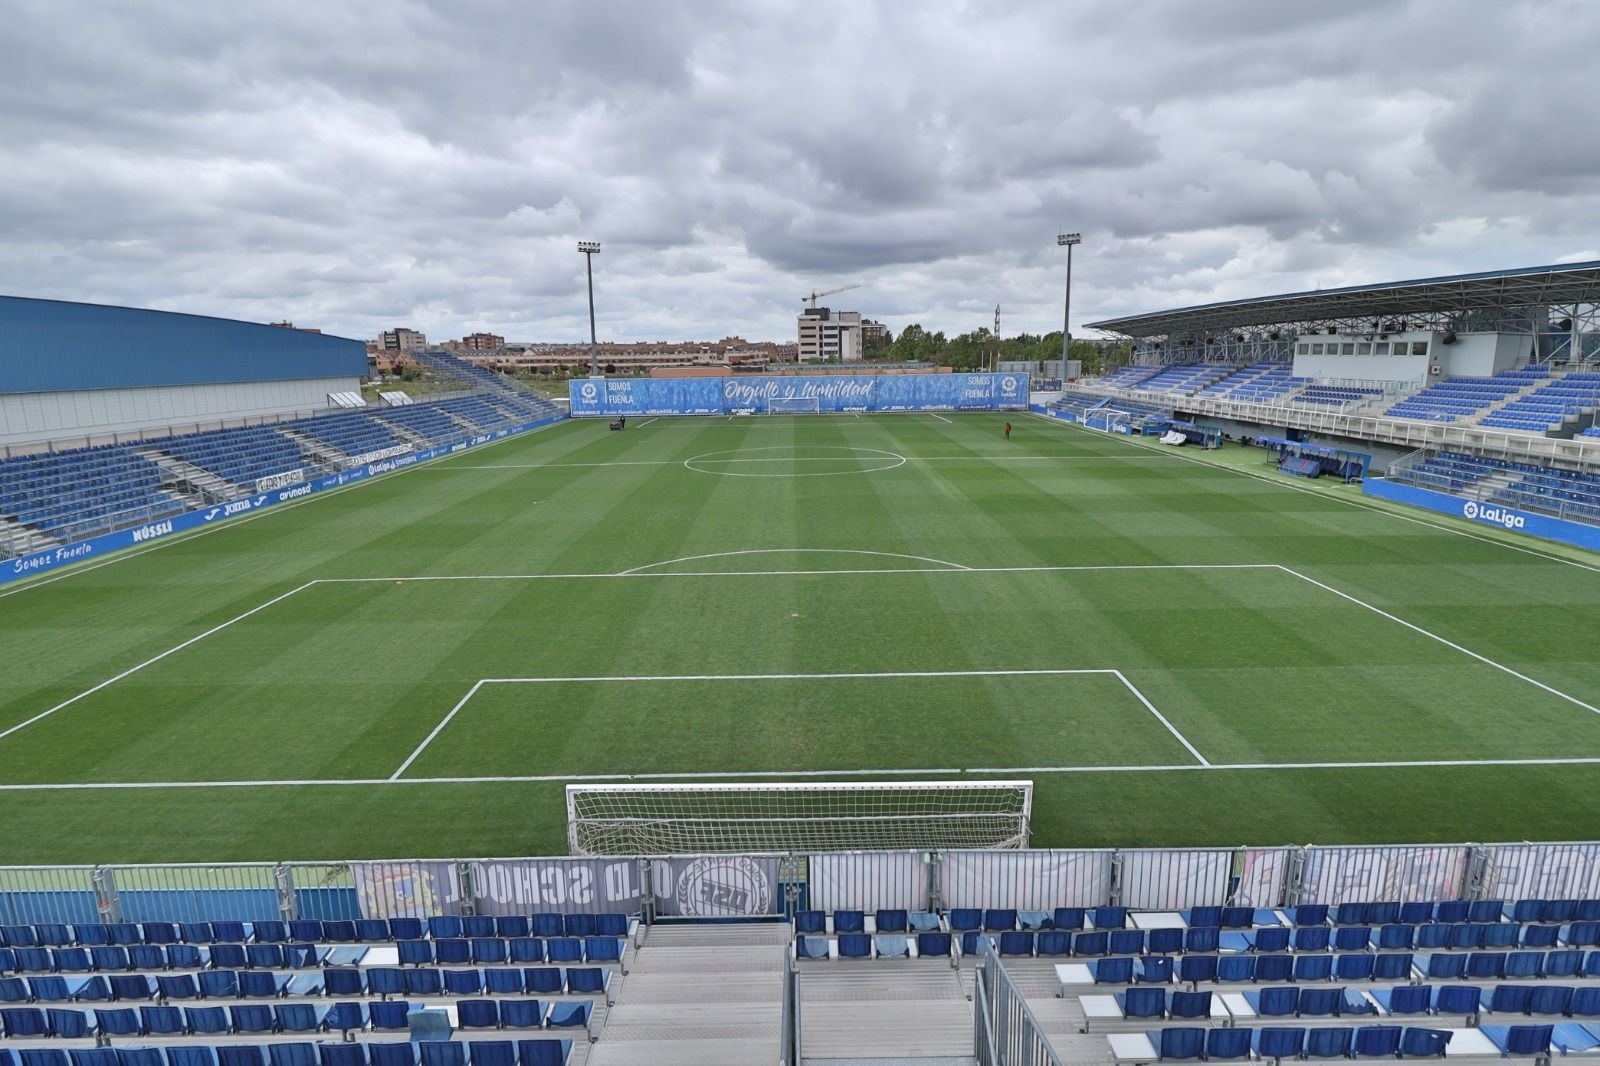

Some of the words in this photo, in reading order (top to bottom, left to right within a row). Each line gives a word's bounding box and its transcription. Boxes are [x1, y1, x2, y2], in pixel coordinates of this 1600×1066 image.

[968, 376, 990, 385] SOMOS
[607, 382, 631, 391] SOMOS
[724, 380, 780, 405] Orgullo
[783, 385, 796, 402] y
[801, 380, 875, 399] humildad
[965, 389, 990, 399] FUENLA
[608, 395, 634, 404] FUENLA
[1479, 505, 1525, 529] LaLiga
[13, 555, 52, 573] Somos
[55, 543, 92, 563] Fuenla
